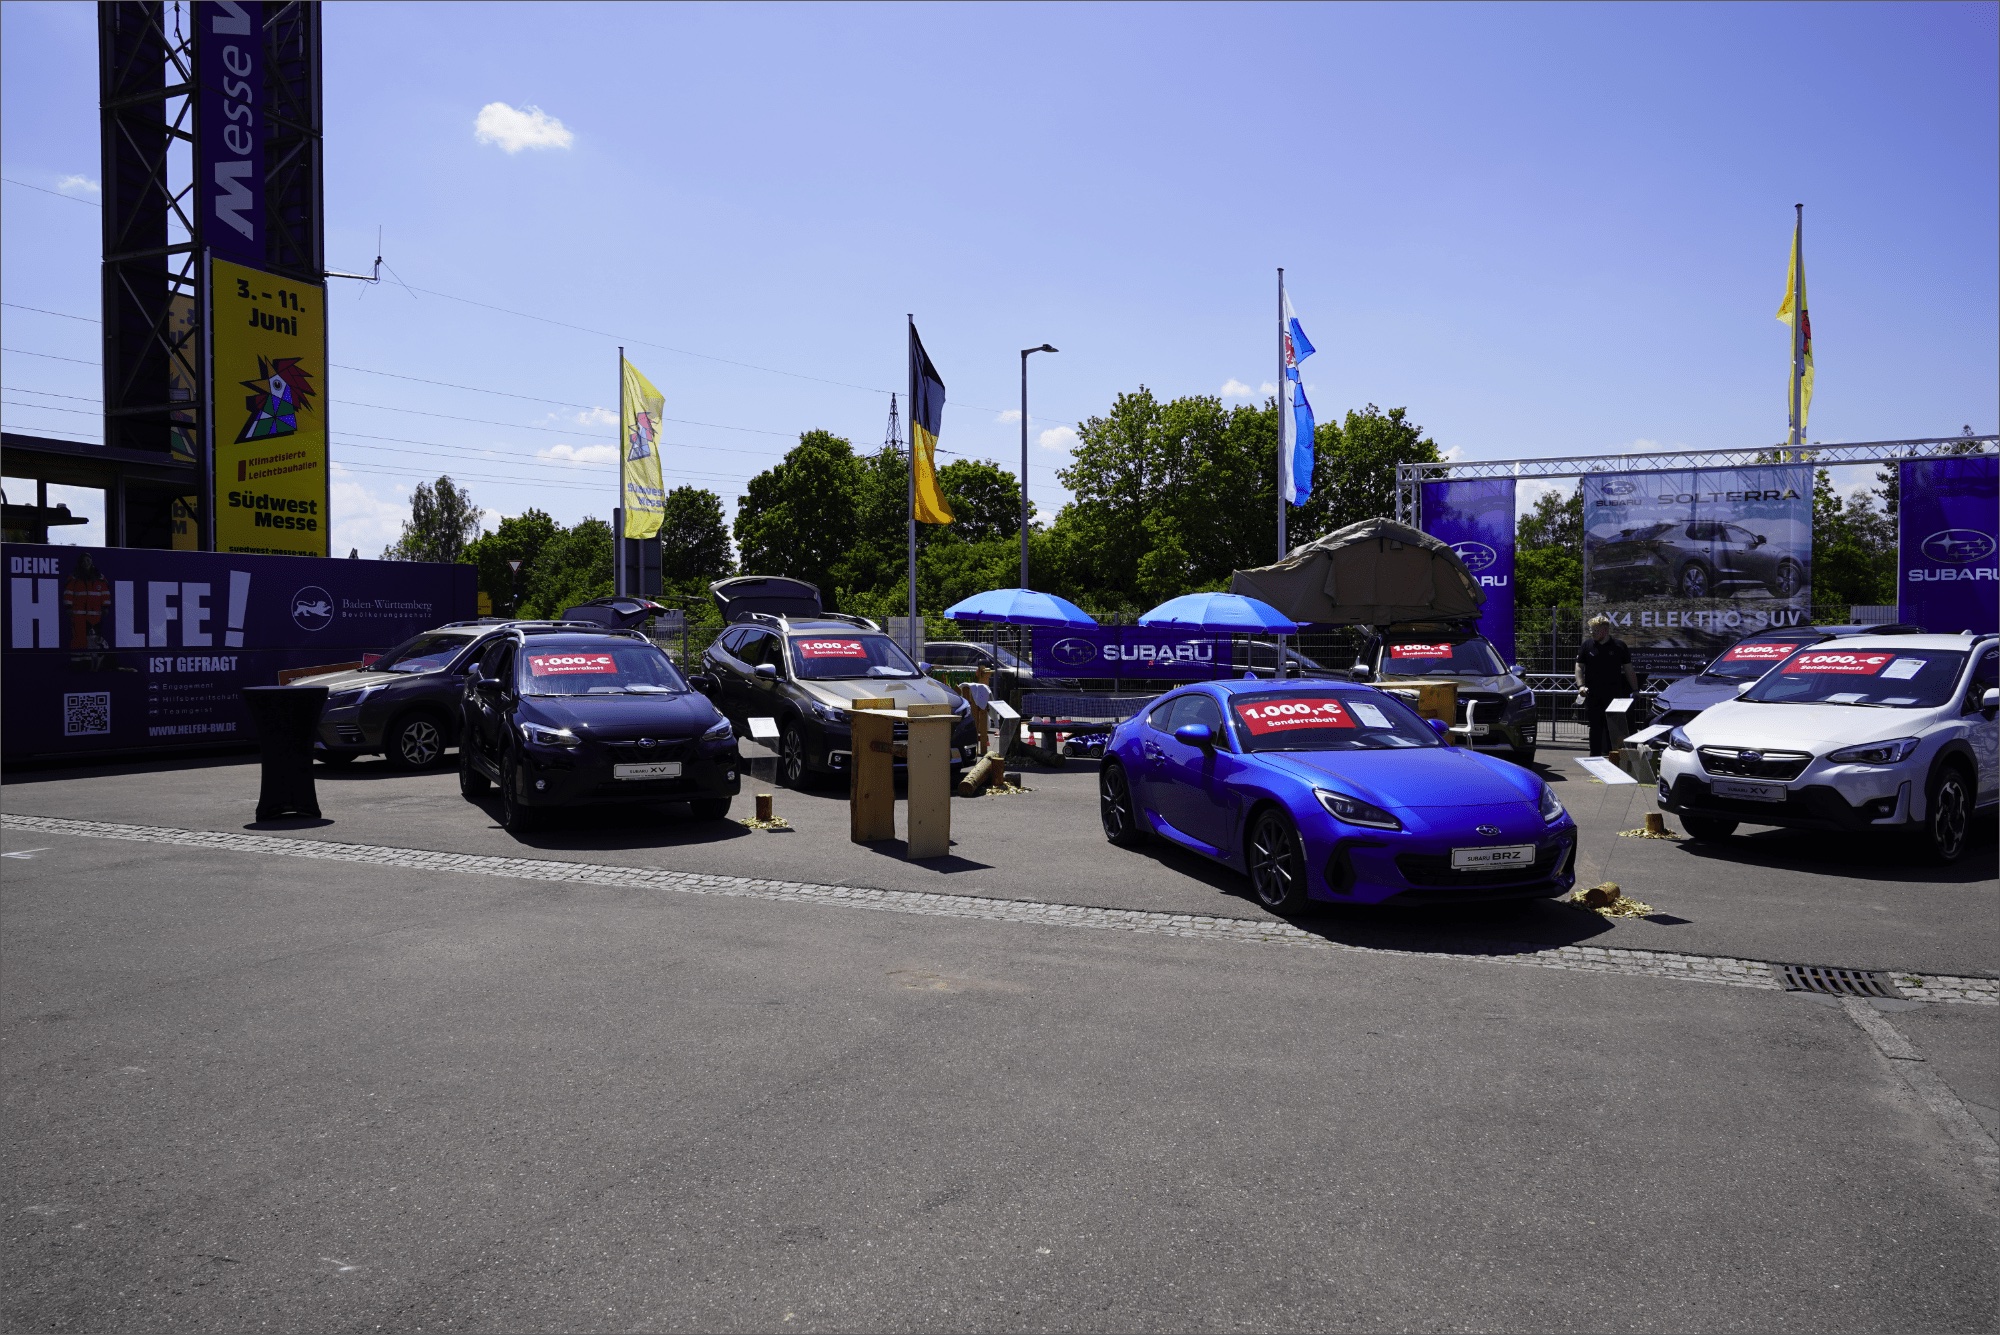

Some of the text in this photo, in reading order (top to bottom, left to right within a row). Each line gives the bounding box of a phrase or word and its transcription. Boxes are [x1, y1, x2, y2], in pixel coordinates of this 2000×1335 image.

[214, 44, 254, 241] Messe
[237, 278, 257, 301] 3.
[279, 290, 305, 313] 11.
[249, 308, 298, 336] Juni
[248, 450, 307, 467] Klimatisierte
[248, 461, 318, 480] Leichtbauhallen
[228, 490, 318, 515] Südwest
[1595, 489, 1802, 507] SUBARU SOLTERRA
[254, 511, 318, 532] Messe
[228, 545, 318, 557] suedwest-messe-vs.de
[10, 556, 60, 575] DEINE
[342, 598, 433, 612] Baden-Württemberg
[1596, 611, 1633, 627] X4
[802, 642, 861, 650] 1.000,-€
[1103, 644, 1213, 661] SUBARU
[1734, 646, 1792, 654] 1.000,-€
[149, 655, 239, 673] IST GEFRAGT
[533, 656, 611, 666] 1.000,-€
[1798, 655, 1886, 665] 1.000,-€
[162, 682, 214, 691] Engagement
[1245, 703, 1342, 719] 1.000,-€
[148, 721, 237, 737] WWW.HELFEN-BW.DE
[1266, 716, 1337, 727] Sonderrabatt
[1492, 851, 1521, 860] BRZ
